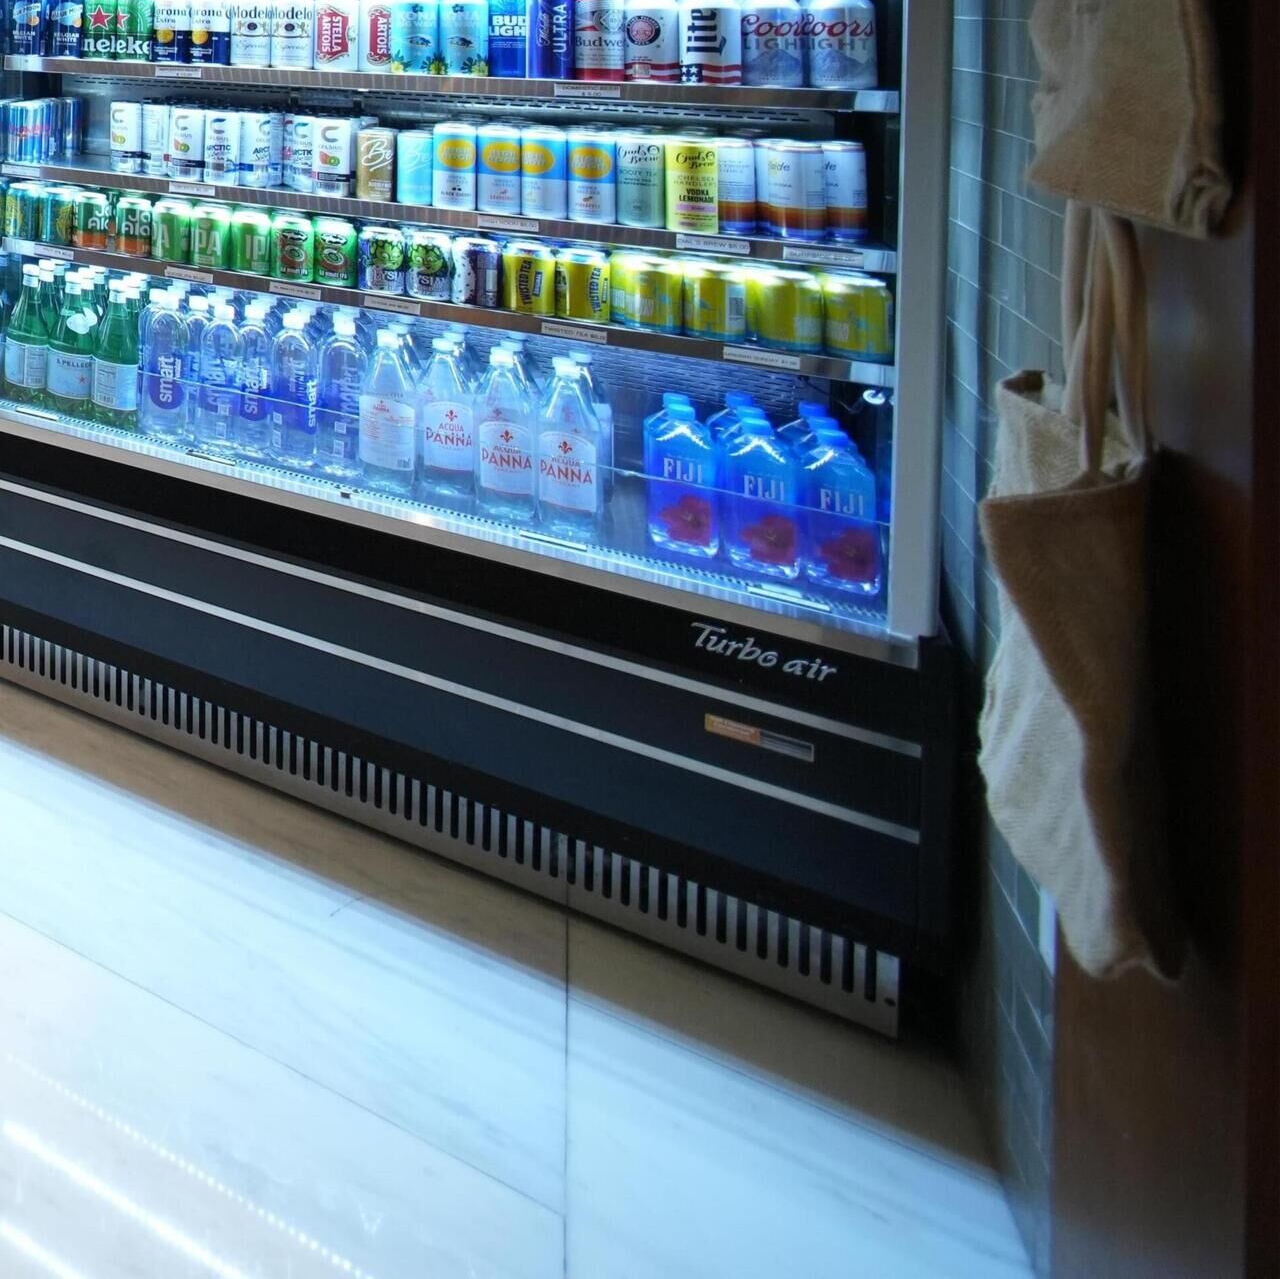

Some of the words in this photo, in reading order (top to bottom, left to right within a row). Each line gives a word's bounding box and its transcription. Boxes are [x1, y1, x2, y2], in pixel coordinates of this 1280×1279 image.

[155, 6, 187, 17] orona
[192, 6, 223, 18] orona
[321, 15, 331, 53] ARTOIS
[332, 16, 342, 52] STELLA
[377, 17, 387, 55] ARTOIS
[490, 26, 527, 37] LIGH
[553, 2, 567, 54] ULTRA
[687, 8, 727, 56] Lite
[799, 13, 875, 37] Coors
[576, 36, 624, 48] Budwe
[253, 146, 270, 155] ARCT
[678, 196, 715, 205] LEMONADE
[686, 188, 709, 196] VODKA
[122, 222, 151, 236] Ala
[245, 234, 270, 260] IP
[157, 355, 172, 403] smart
[425, 427, 472, 447] PANNA
[438, 422, 464, 432] ACQUA
[481, 448, 532, 469] PANNA
[663, 457, 702, 483] FIJI
[540, 460, 593, 484] PANNA
[744, 474, 785, 500] FIJI
[820, 488, 864, 515] FIJI
[690, 621, 779, 666] Turbo
[782, 657, 837, 682] air
